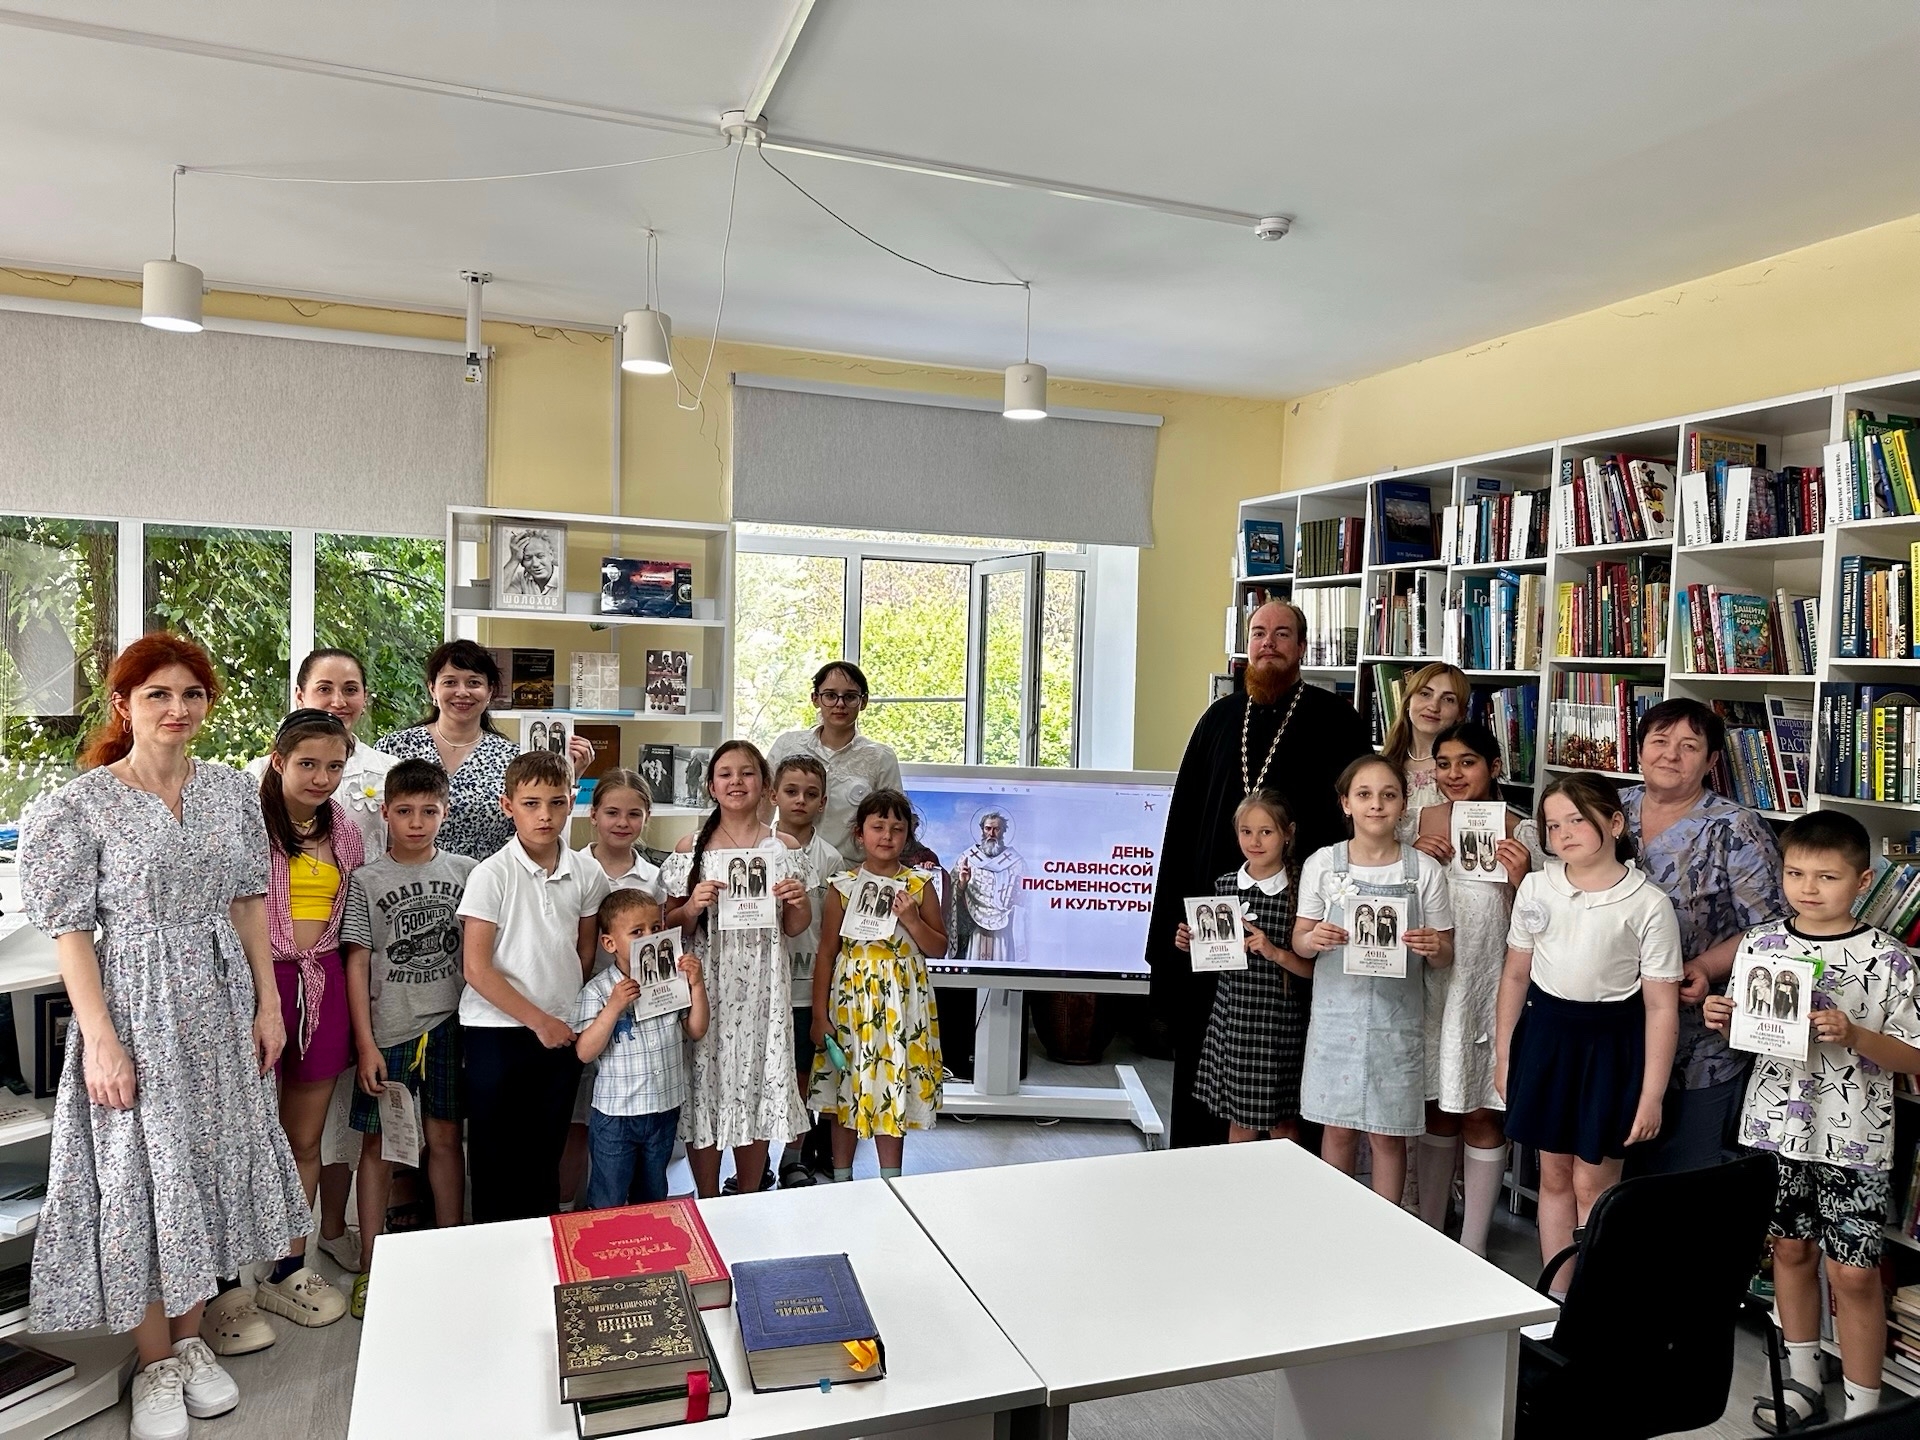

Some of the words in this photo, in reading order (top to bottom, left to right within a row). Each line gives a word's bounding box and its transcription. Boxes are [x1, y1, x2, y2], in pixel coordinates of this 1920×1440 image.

[502, 595, 558, 606] ШОЛОХОВ
[1473, 589, 1490, 608] Гр
[1733, 604, 1766, 616] ЗАЩИТА
[1736, 617, 1763, 626] БОРЬБЫ
[1876, 726, 1884, 751] ВИРУС
[1112, 846, 1154, 859] ДЕНЬ
[1044, 861, 1153, 876] СЛАВЯНСКОЙ
[1022, 878, 1152, 894] ПИСЬМЕННОСТИ
[376, 881, 423, 913] ROAD
[1050, 897, 1061, 909] И
[1065, 898, 1152, 912] КУЛЬТУРЫ
[401, 911, 425, 935] 500
[426, 908, 446, 922] MILES
[386, 957, 459, 984] MOTORCYC
